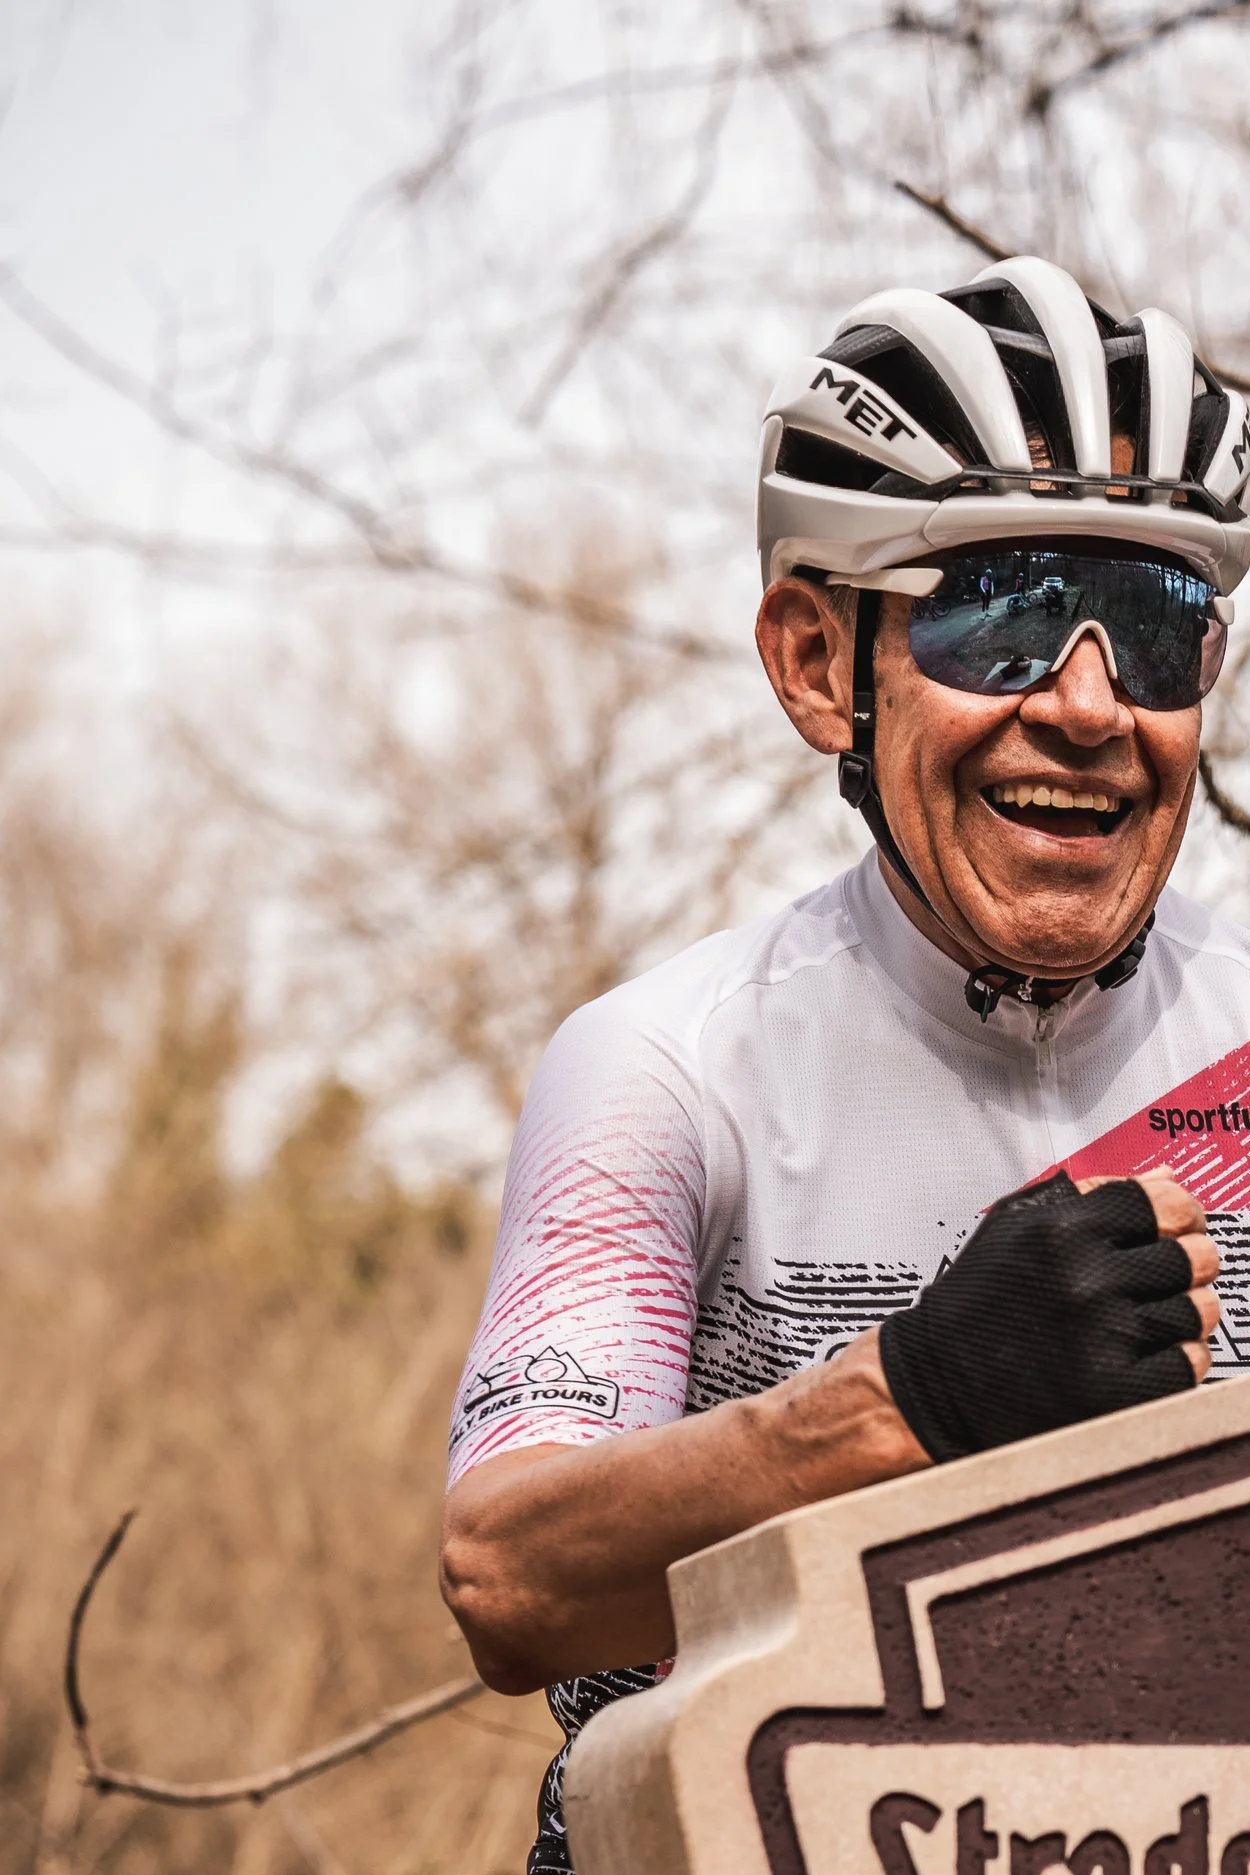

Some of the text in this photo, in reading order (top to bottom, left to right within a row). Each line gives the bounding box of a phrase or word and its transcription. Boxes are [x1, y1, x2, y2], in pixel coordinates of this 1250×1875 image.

[809, 367, 918, 442] MET
[478, 1392, 524, 1421] BIKE
[530, 1388, 609, 1407] TOURS
